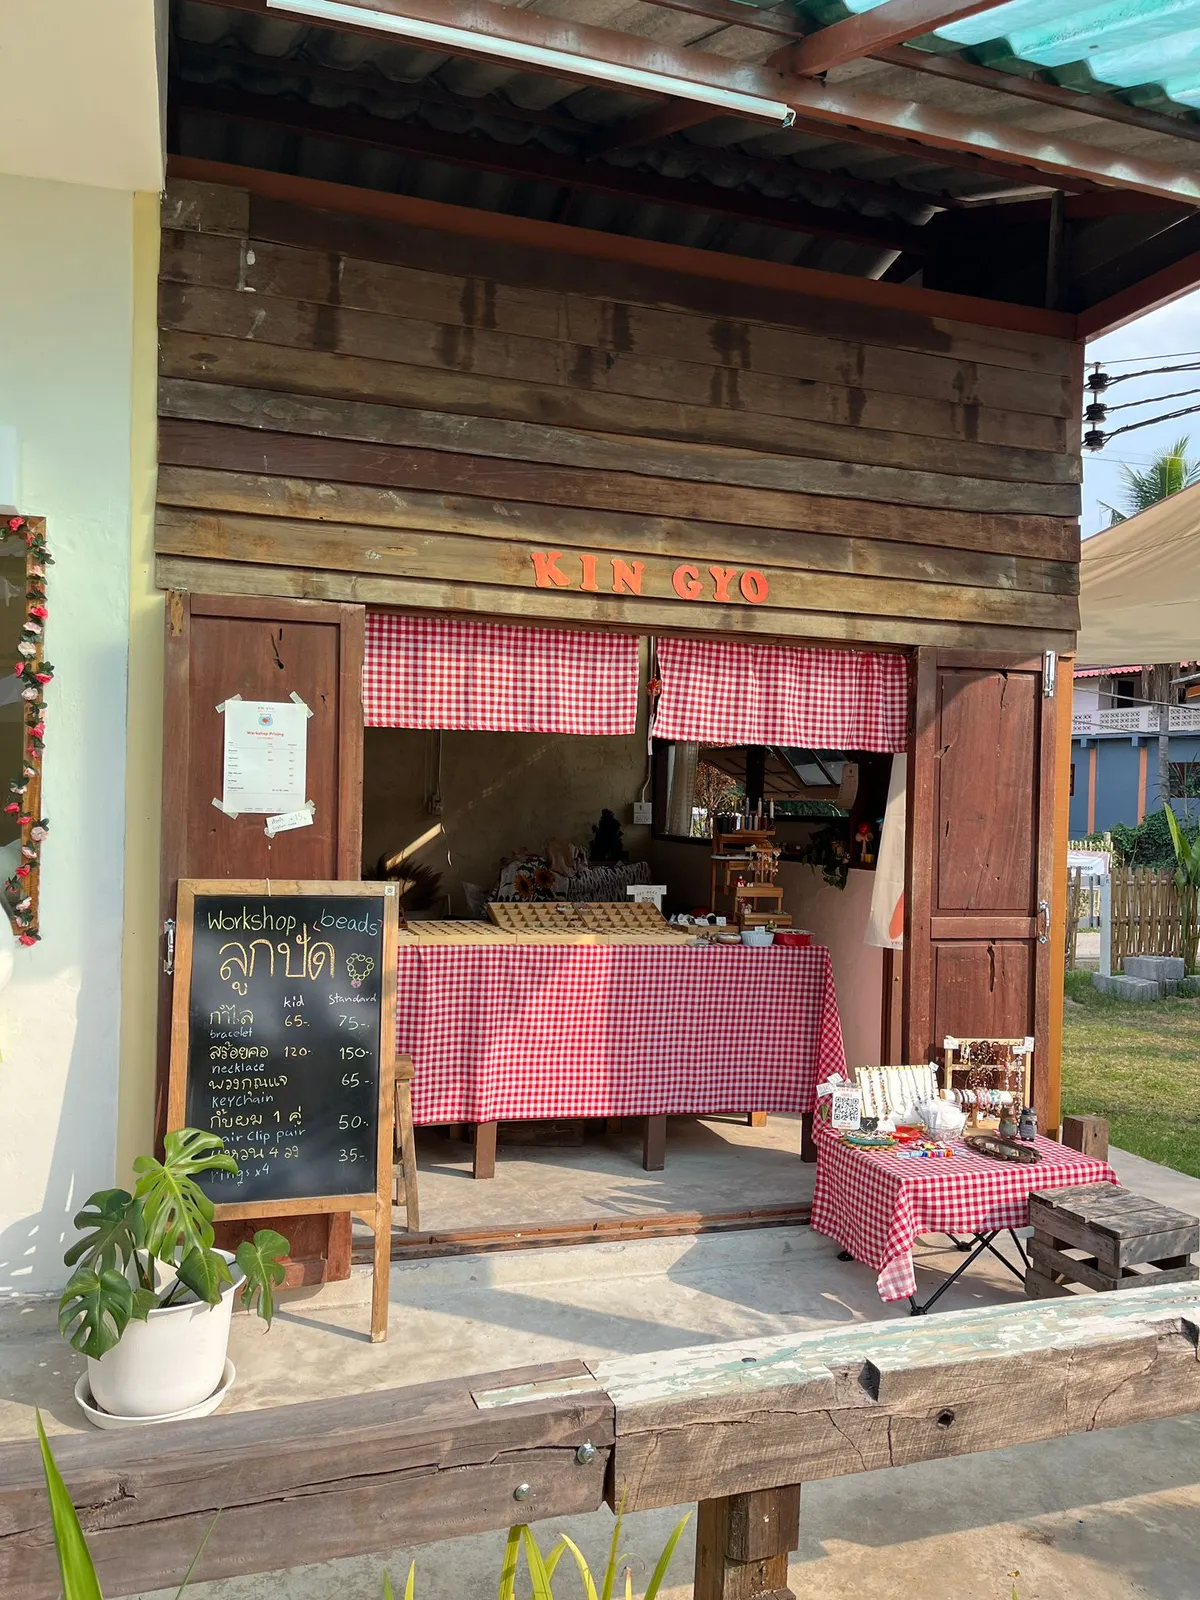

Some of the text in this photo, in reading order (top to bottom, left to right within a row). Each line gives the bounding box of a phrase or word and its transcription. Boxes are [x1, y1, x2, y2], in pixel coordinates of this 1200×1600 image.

[530, 551, 769, 604] KIN GYO
[207, 906, 296, 936] Workshop
[219, 923, 335, 996] ลูกปัด
[209, 1041, 269, 1061] สร้อยคอ
[211, 1063, 265, 1074] necklace
[273, 1111, 280, 1123] 1
